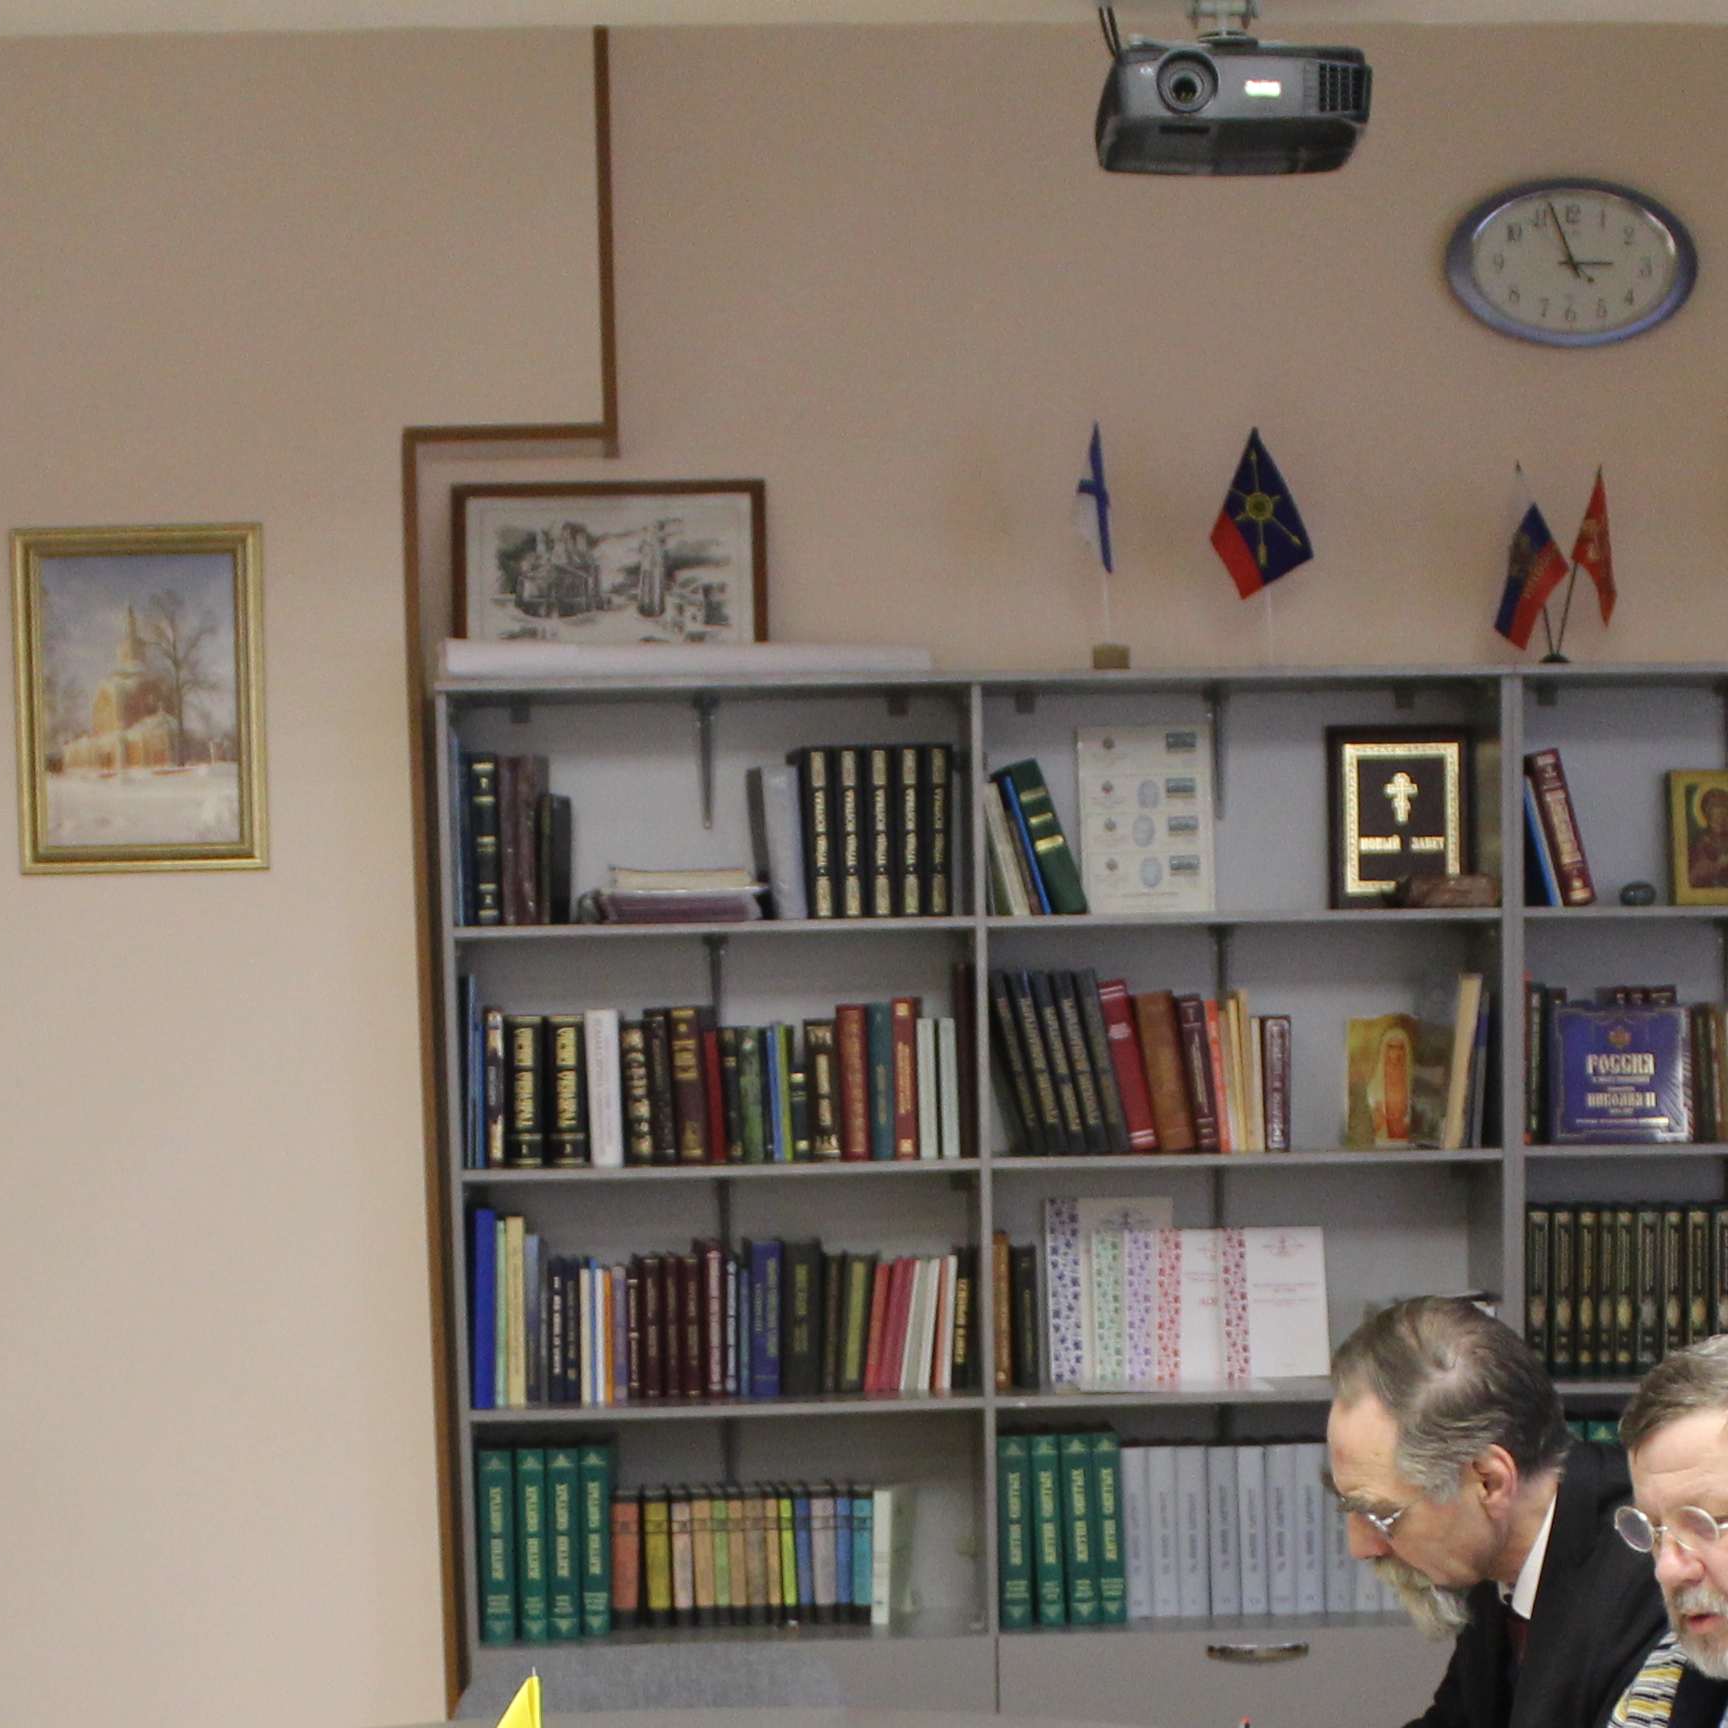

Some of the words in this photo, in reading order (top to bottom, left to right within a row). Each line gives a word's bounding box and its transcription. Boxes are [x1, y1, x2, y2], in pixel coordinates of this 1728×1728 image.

[1565, 204, 1582, 224] 12
[1623, 226, 1635, 246] 2
[1639, 256, 1652, 277] 3
[1586, 1053, 1655, 1075] РОССИЯ
